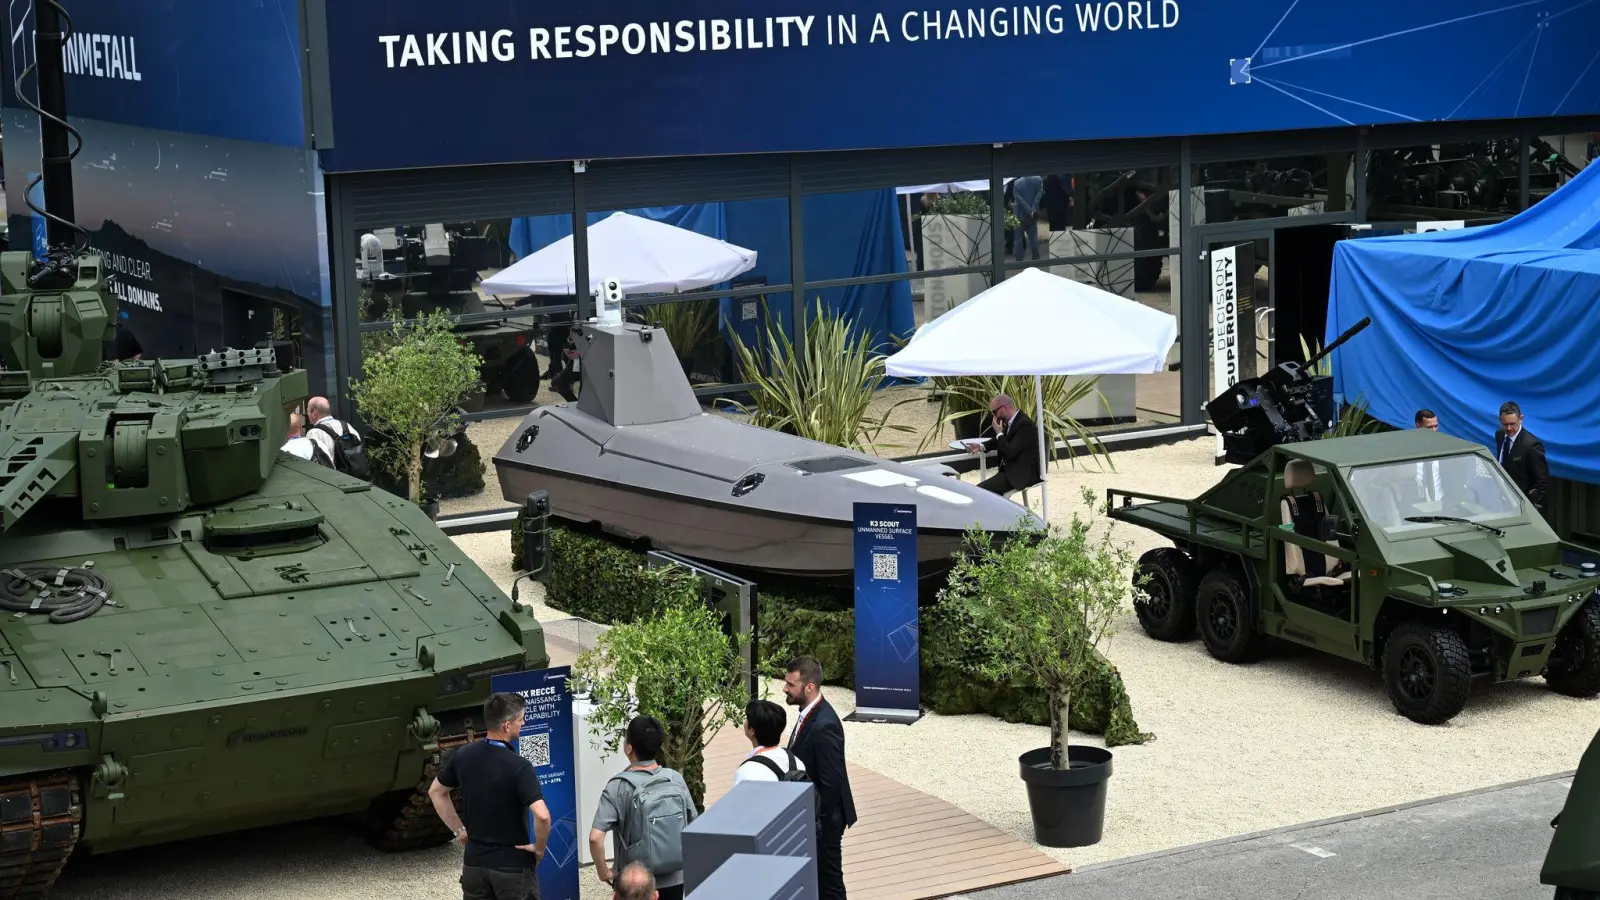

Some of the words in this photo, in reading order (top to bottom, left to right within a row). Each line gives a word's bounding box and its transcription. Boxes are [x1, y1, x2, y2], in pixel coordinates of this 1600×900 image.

[379, 29, 515, 68] TAKING
[530, 16, 815, 60] RESPONSIBILITY
[827, 15, 857, 45] IN
[870, 13, 891, 43] A
[902, 5, 1064, 41] CHANGING
[1075, 0, 1179, 32] WORLD
[61, 31, 142, 81] INMETALL
[113, 254, 128, 274] AND
[114, 280, 128, 301] ALL
[127, 284, 163, 313] DOMAINS.
[1216, 259, 1226, 351] DECISION
[1224, 256, 1236, 387] SUPERIORITY
[879, 520, 900, 528] SCOUT
[525, 694, 562, 706] NAISSANCE
[530, 686, 556, 698] RECCE
[524, 710, 561, 722] CAPABILITY
[538, 703, 555, 712] WITH
